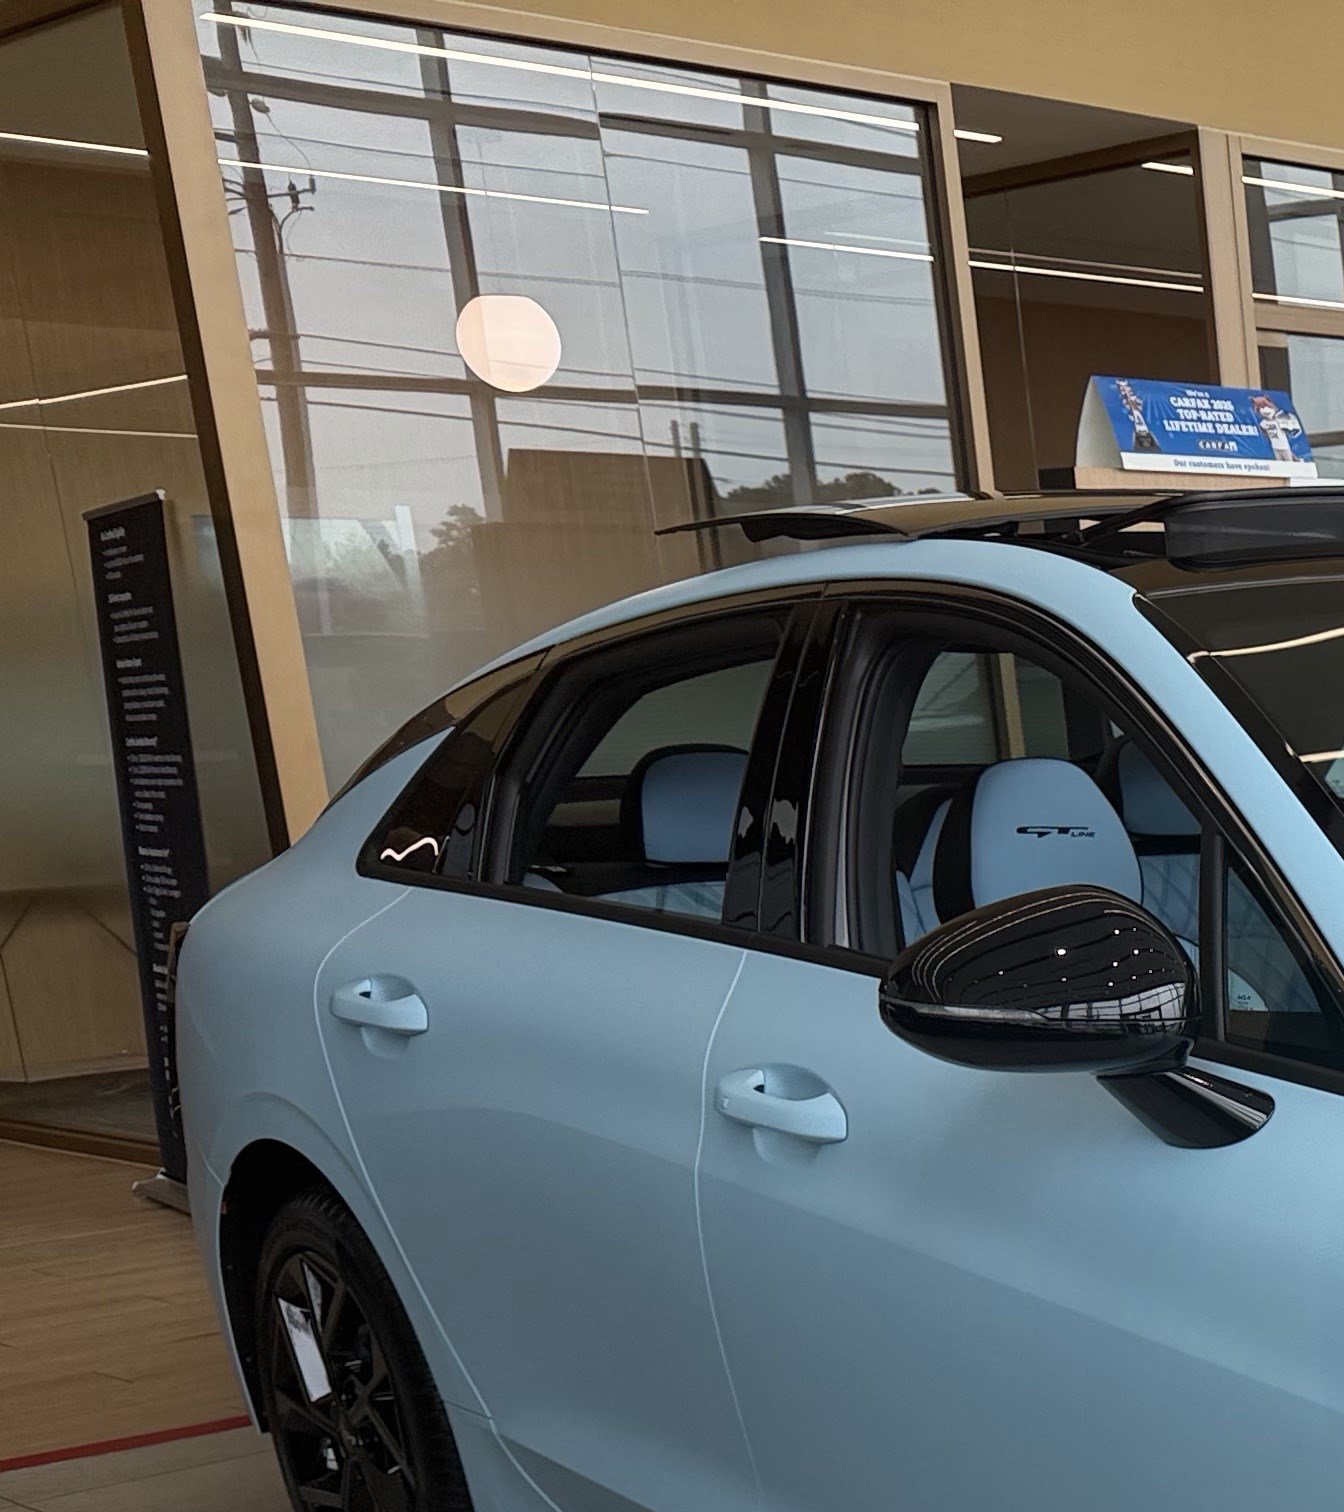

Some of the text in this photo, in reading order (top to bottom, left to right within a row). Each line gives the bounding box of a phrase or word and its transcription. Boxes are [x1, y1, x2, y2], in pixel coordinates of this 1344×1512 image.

[1170, 397, 1211, 409] CARFAX
[1177, 409, 1234, 422] TOP-RATED
[1163, 420, 1215, 433] LIFETIME
[1173, 459, 1187, 467] Our
[1188, 461, 1224, 469] customers
[1226, 461, 1243, 470] have
